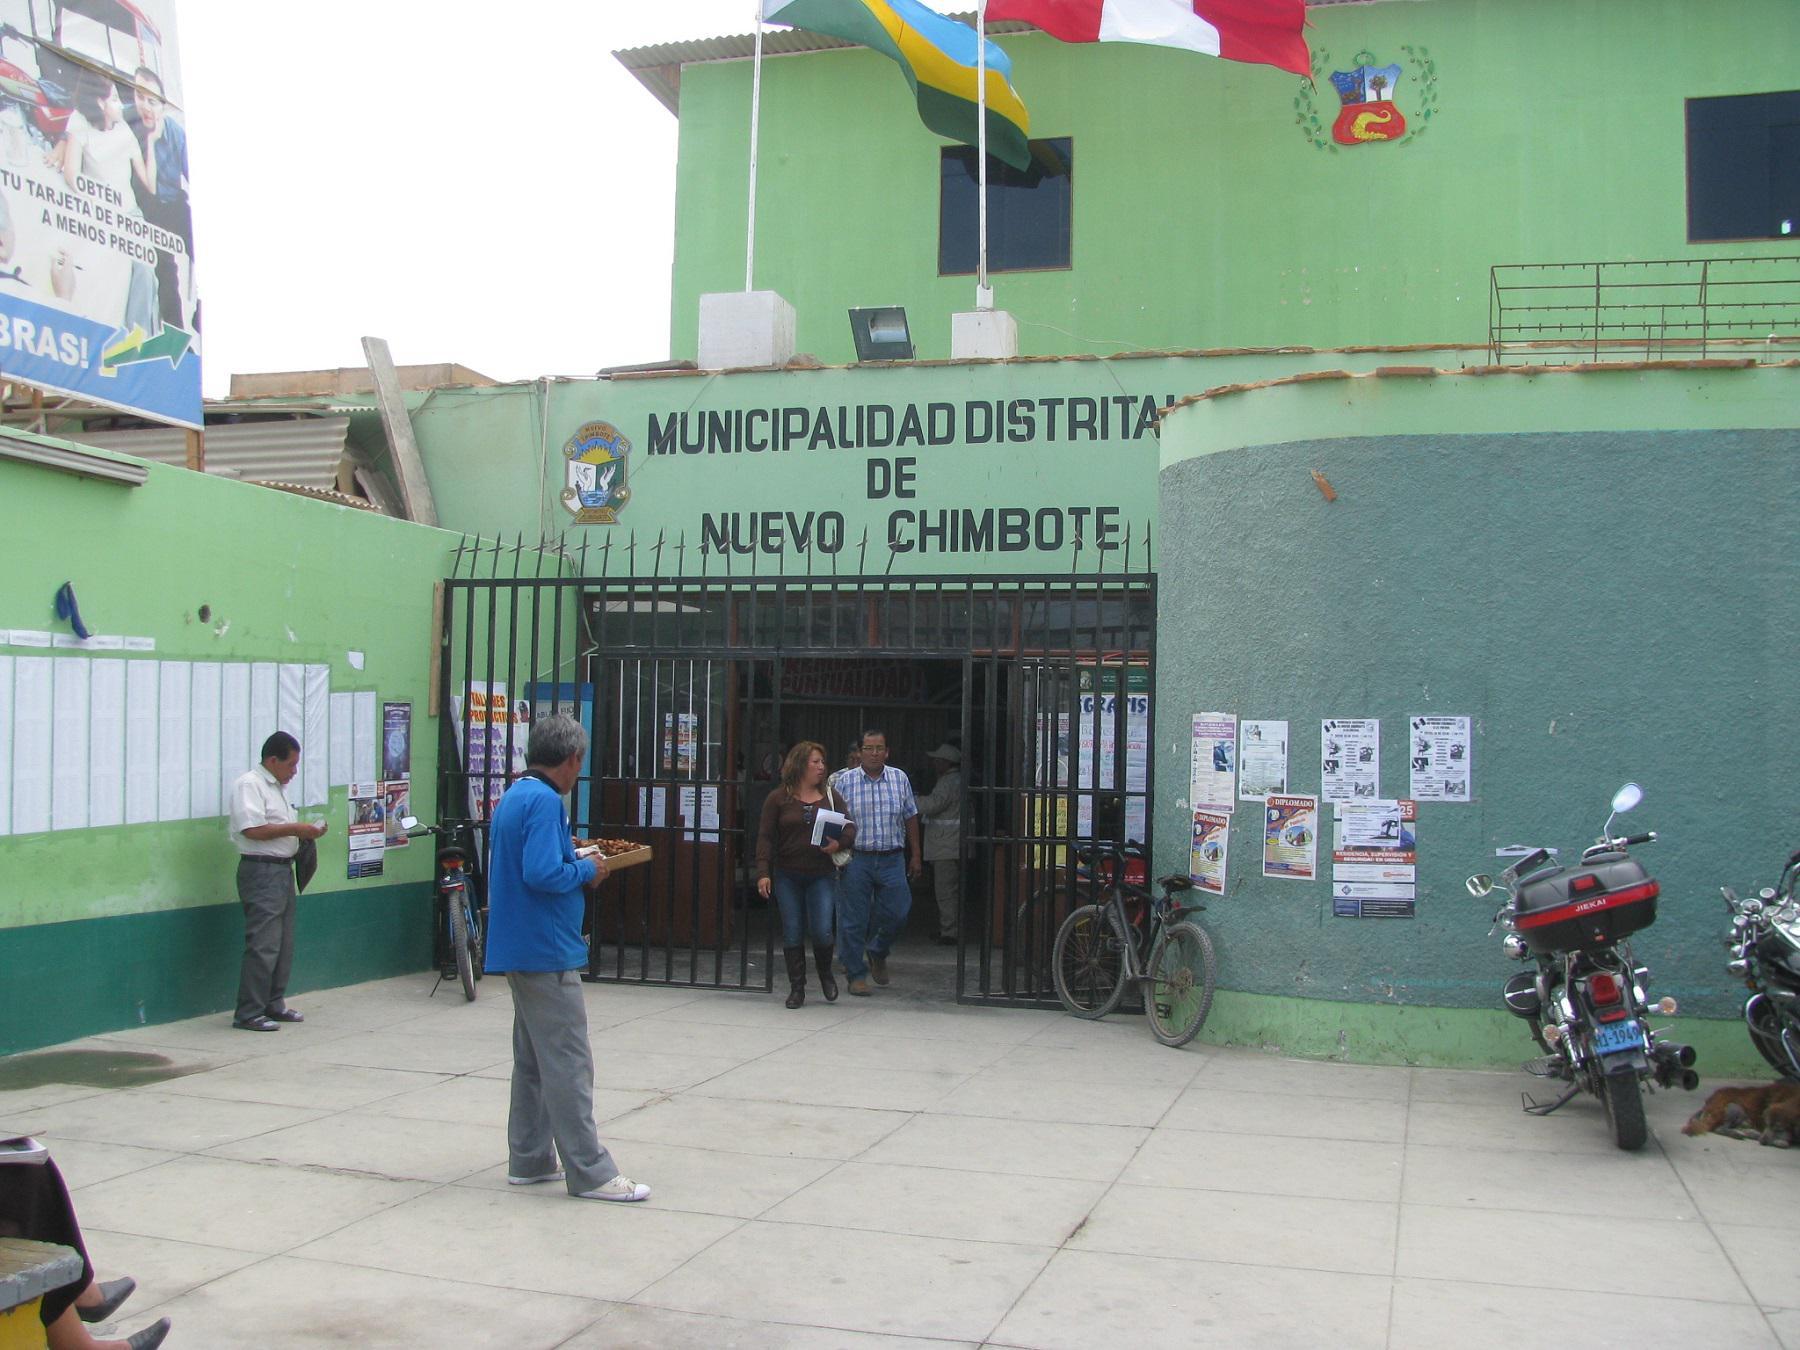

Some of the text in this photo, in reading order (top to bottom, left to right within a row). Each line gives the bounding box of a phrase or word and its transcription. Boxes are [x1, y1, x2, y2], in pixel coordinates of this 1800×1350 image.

[1, 169, 184, 254] TU TARJETA DE PROPIEDAD
[76, 175, 122, 208] OBTÉN
[42, 209, 156, 265] A MENOS PRECIO
[648, 394, 1175, 455] MUNICIPALIDAD DISTRITA
[867, 457, 916, 499] DE
[701, 506, 1120, 554] NUEVO CHIMBOTE
